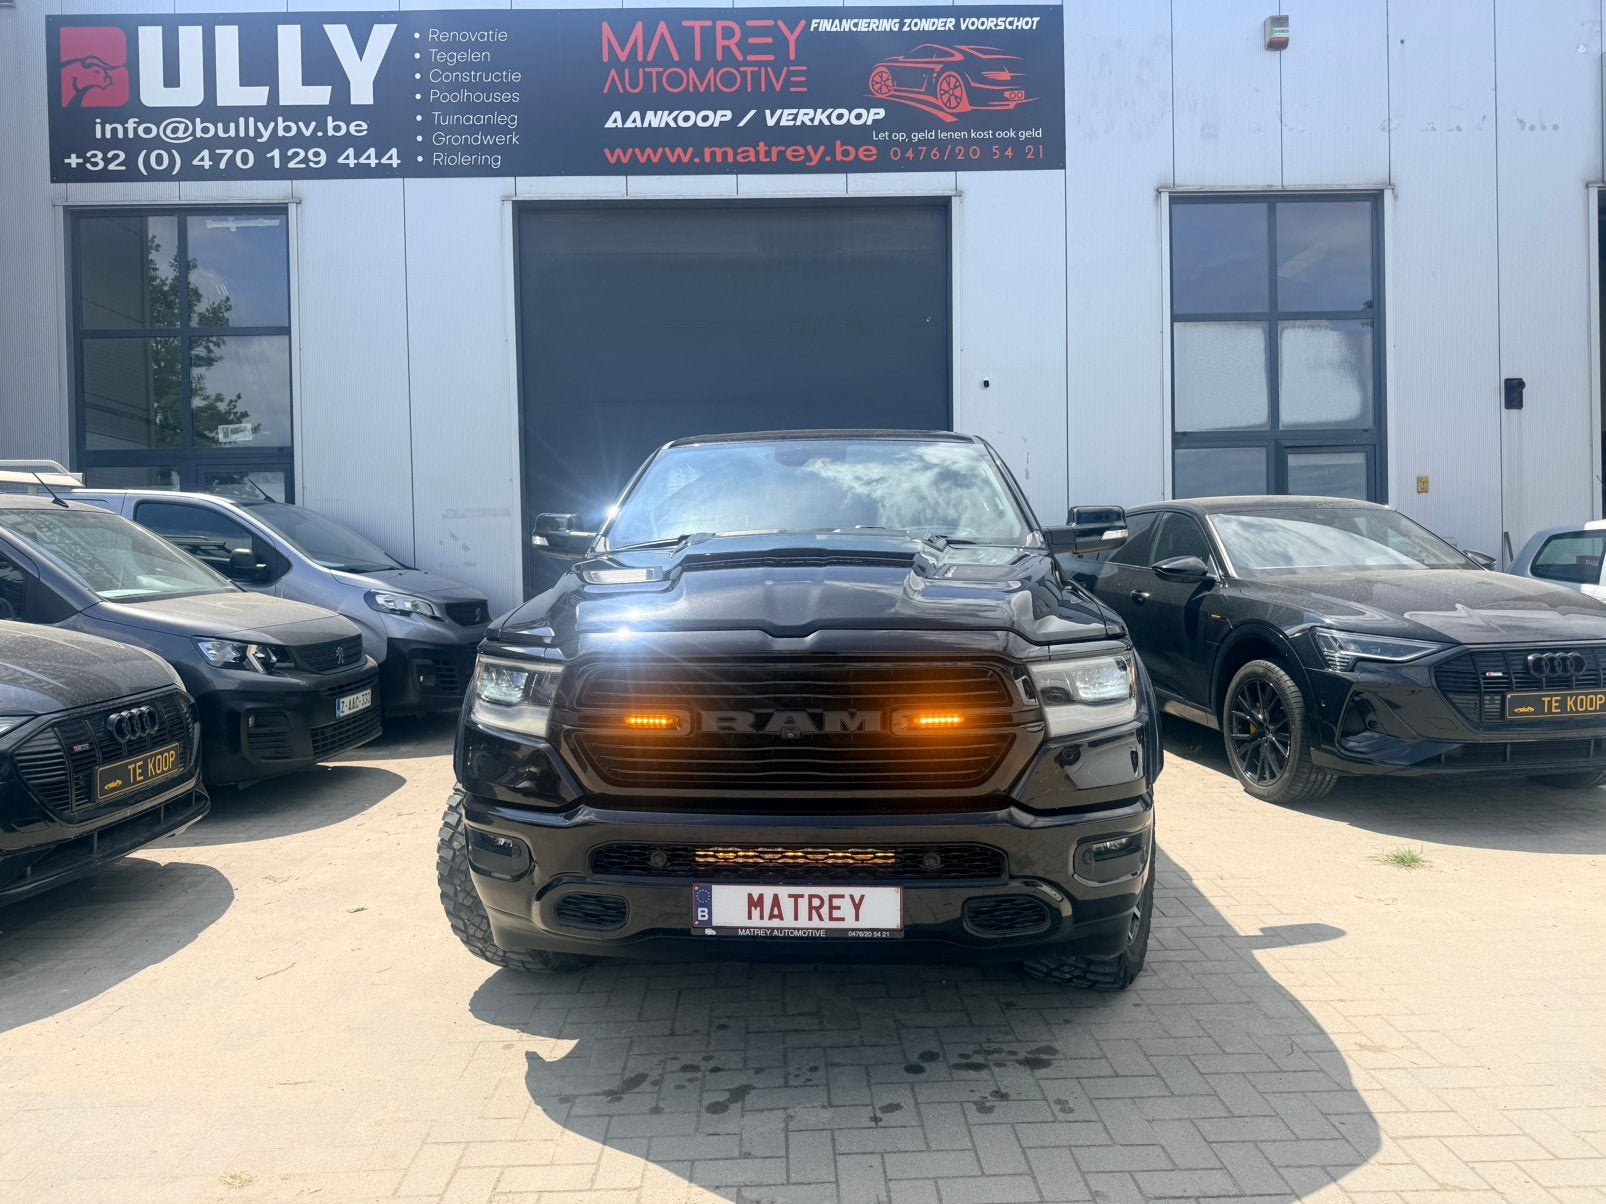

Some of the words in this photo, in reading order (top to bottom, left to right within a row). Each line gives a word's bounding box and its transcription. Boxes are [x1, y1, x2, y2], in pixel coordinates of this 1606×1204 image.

[810, 18, 900, 32] FINANCIERING
[902, 17, 955, 32] ZONDER
[959, 16, 1040, 31] VOORSCHOT
[428, 28, 508, 42] Renovatie
[601, 19, 807, 63] MATREY
[428, 48, 491, 66] Tegelen
[429, 68, 522, 83] Constructie
[603, 66, 808, 94] AUTOMOTIVE
[430, 88, 520, 103] Poolhouses
[432, 111, 518, 129] Tuinaanleg
[604, 110, 733, 128] AANKOOP
[764, 108, 886, 127] VERKOOP
[95, 115, 369, 144] info@bullybv.be
[432, 131, 520, 146] Grondwerk
[872, 130, 890, 141] Let
[891, 132, 908, 142] op,
[911, 129, 935, 142] geld
[938, 129, 968, 140] lenen
[970, 128, 994, 139] kost
[995, 128, 1017, 138] ook
[1018, 128, 1042, 141] geld
[64, 149, 127, 171] +32
[137, 149, 182, 176] (0)
[191, 148, 255, 170] 470
[266, 147, 327, 169] 129
[336, 147, 401, 168] 444
[433, 151, 501, 169] Riolering
[603, 140, 878, 166] www.matrey.be
[890, 145, 981, 161] 0476/20
[992, 145, 1014, 159] 54
[1025, 145, 1044, 159] 21
[1542, 697, 1562, 713] TE
[1567, 694, 1606, 712] KOOP
[701, 710, 883, 732] RAM
[128, 761, 144, 783] TE
[148, 750, 176, 777] KOOP
[697, 907, 709, 921] B
[747, 892, 866, 922] MATREY
[738, 928, 772, 937] MATREY
[772, 929, 826, 938] AUTOMOTIVE
